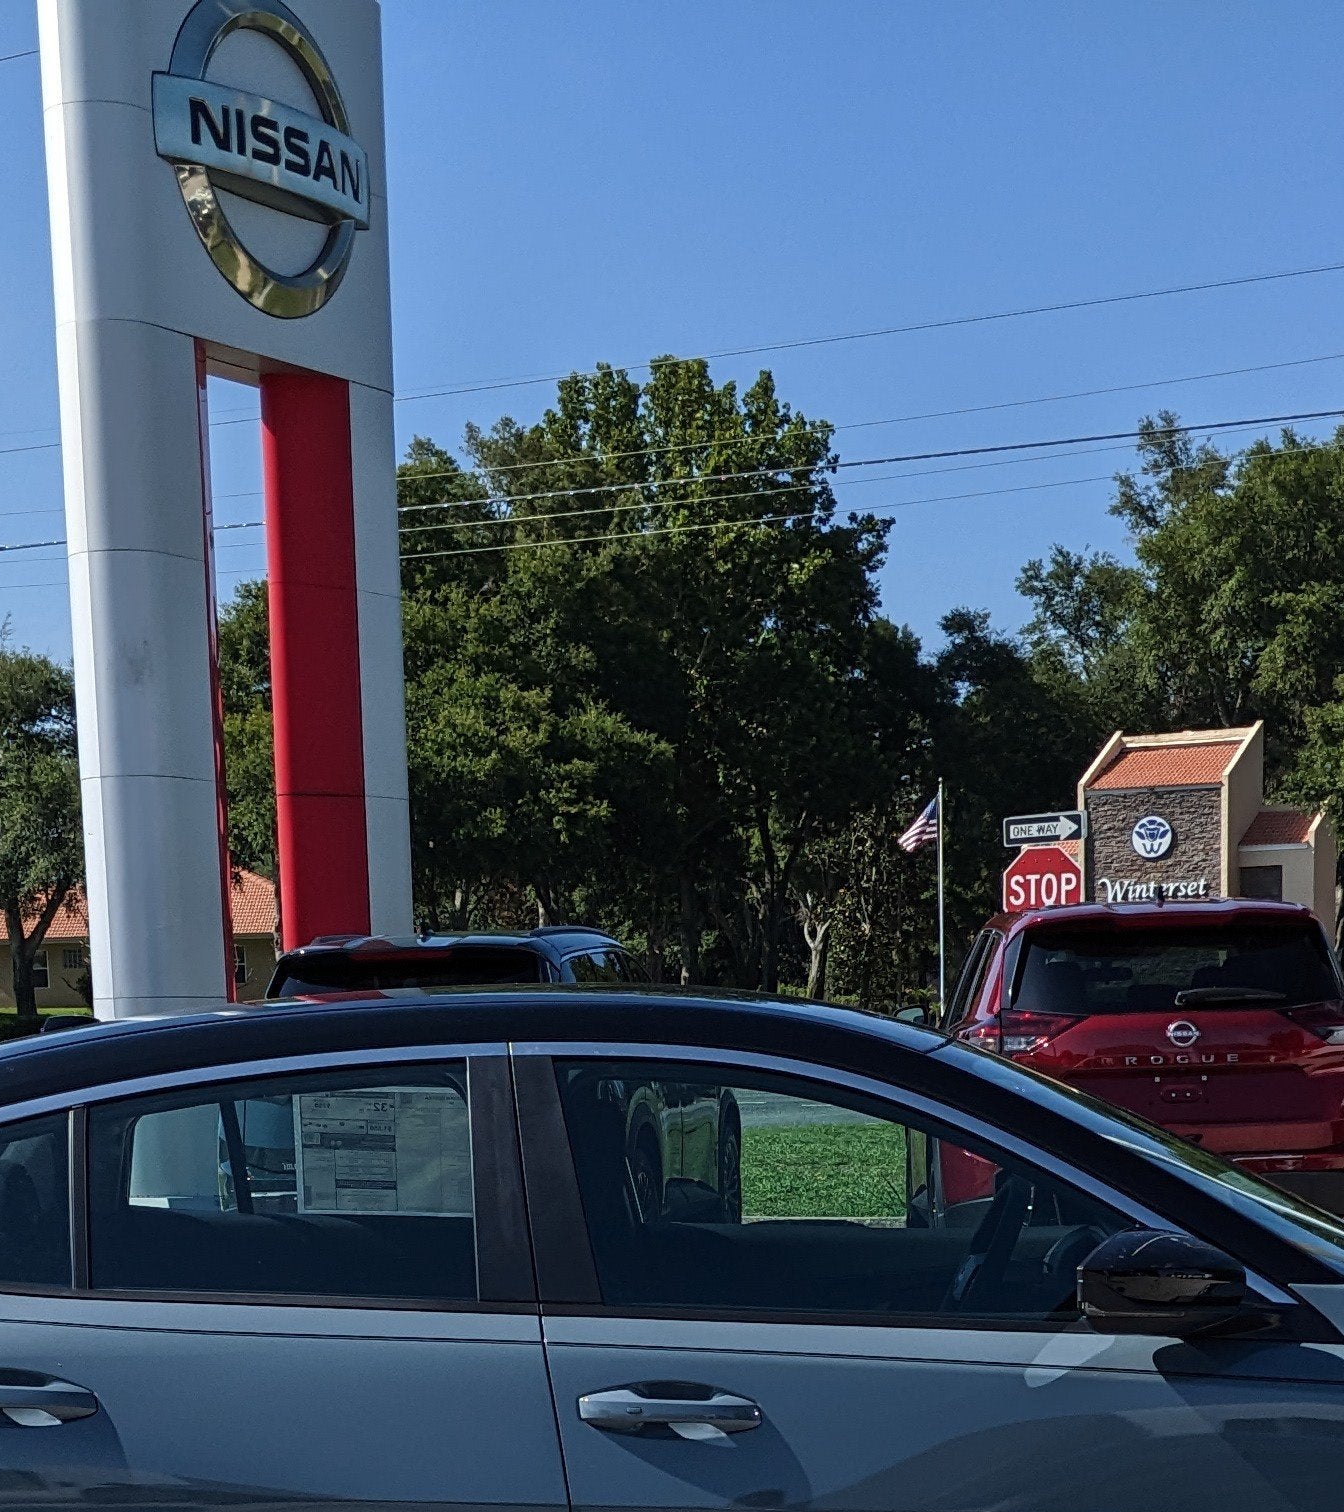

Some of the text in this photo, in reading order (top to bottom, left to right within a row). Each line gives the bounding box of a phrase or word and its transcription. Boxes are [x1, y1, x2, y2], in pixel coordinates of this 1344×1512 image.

[189, 96, 362, 204] NISSAN
[1012, 823, 1059, 837] ONE WAY
[1009, 873, 1077, 906] STOP
[1125, 1053, 1239, 1066] ROGUE
